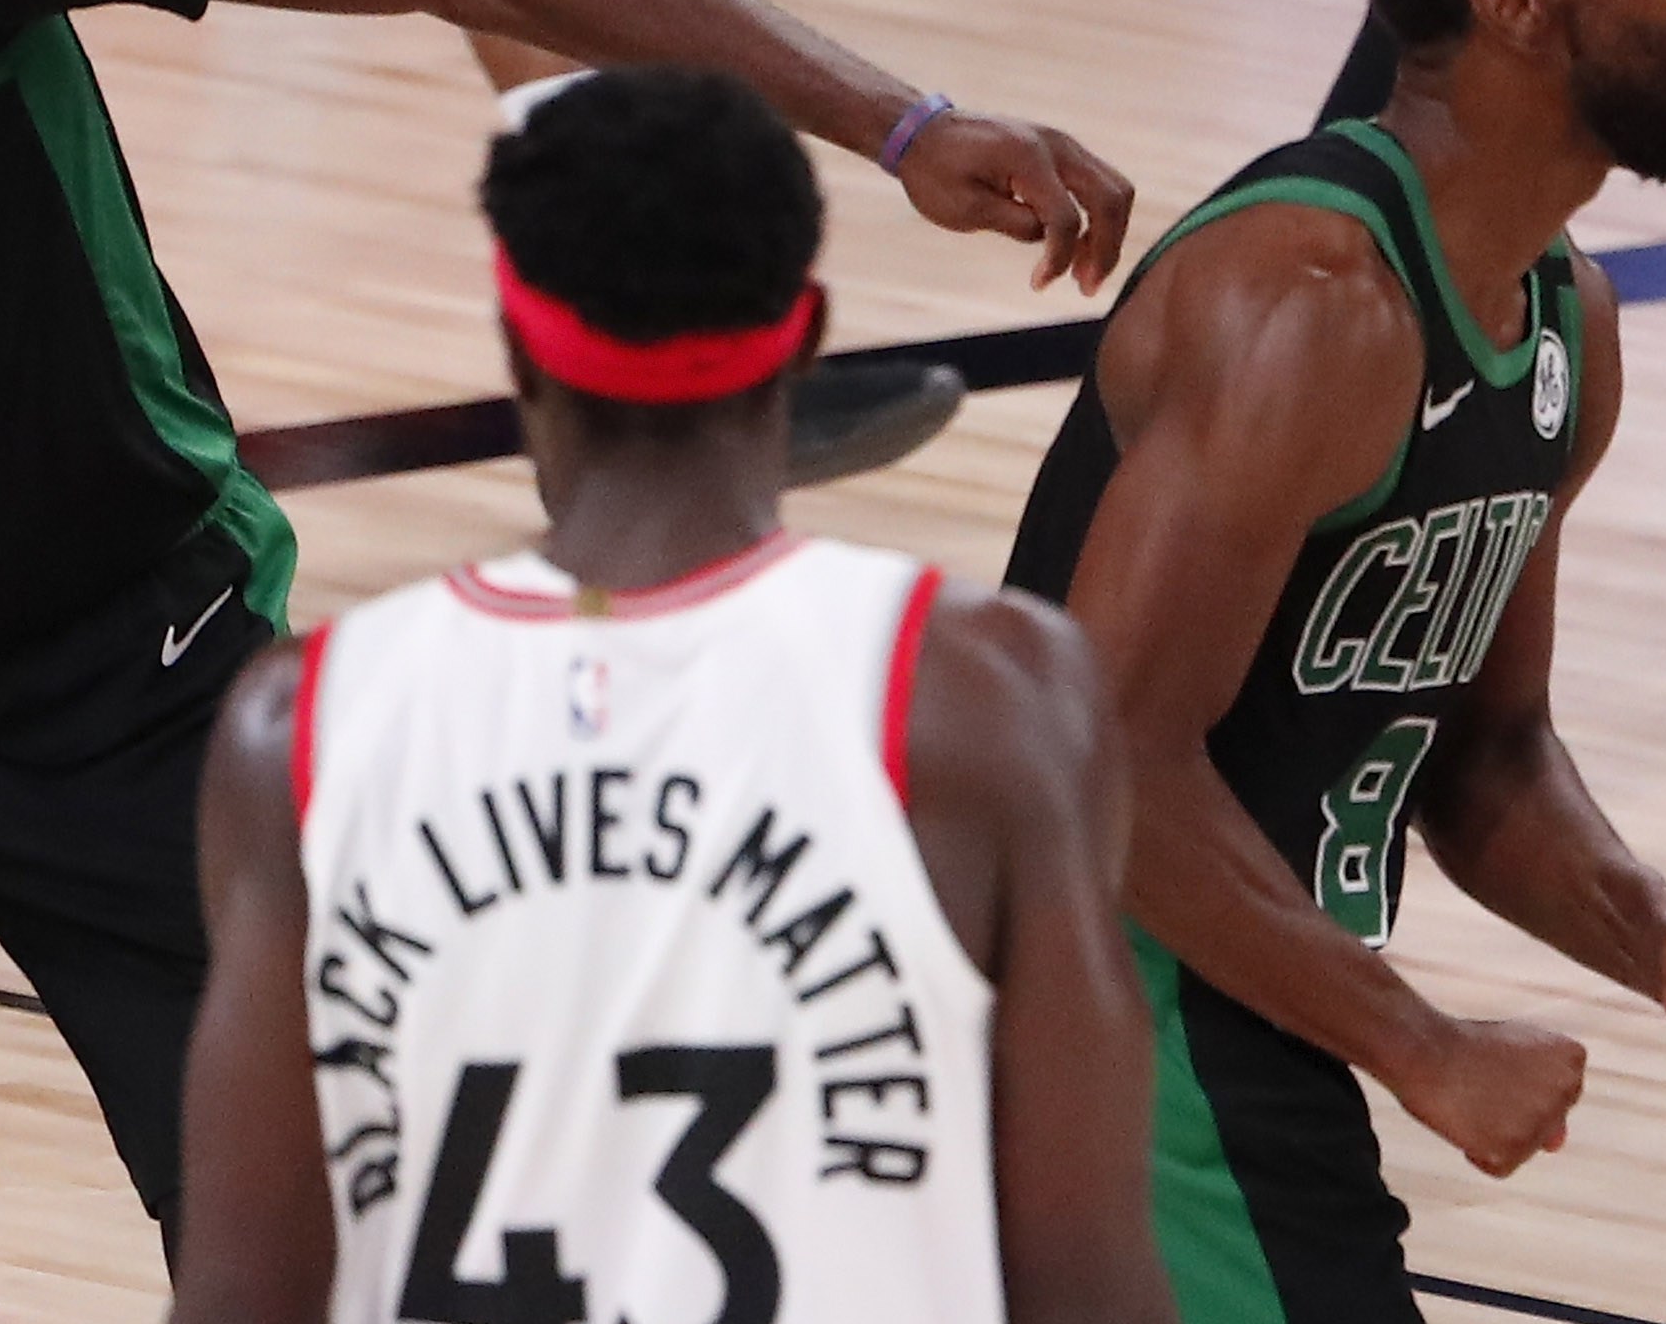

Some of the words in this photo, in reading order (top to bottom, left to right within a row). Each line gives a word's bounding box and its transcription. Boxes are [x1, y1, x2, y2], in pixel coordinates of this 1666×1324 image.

[1292, 491, 1549, 695] CELTI
[1314, 716, 1438, 948] 8
[417, 767, 703, 916] LIVES
[708, 808, 929, 1187] MATTER
